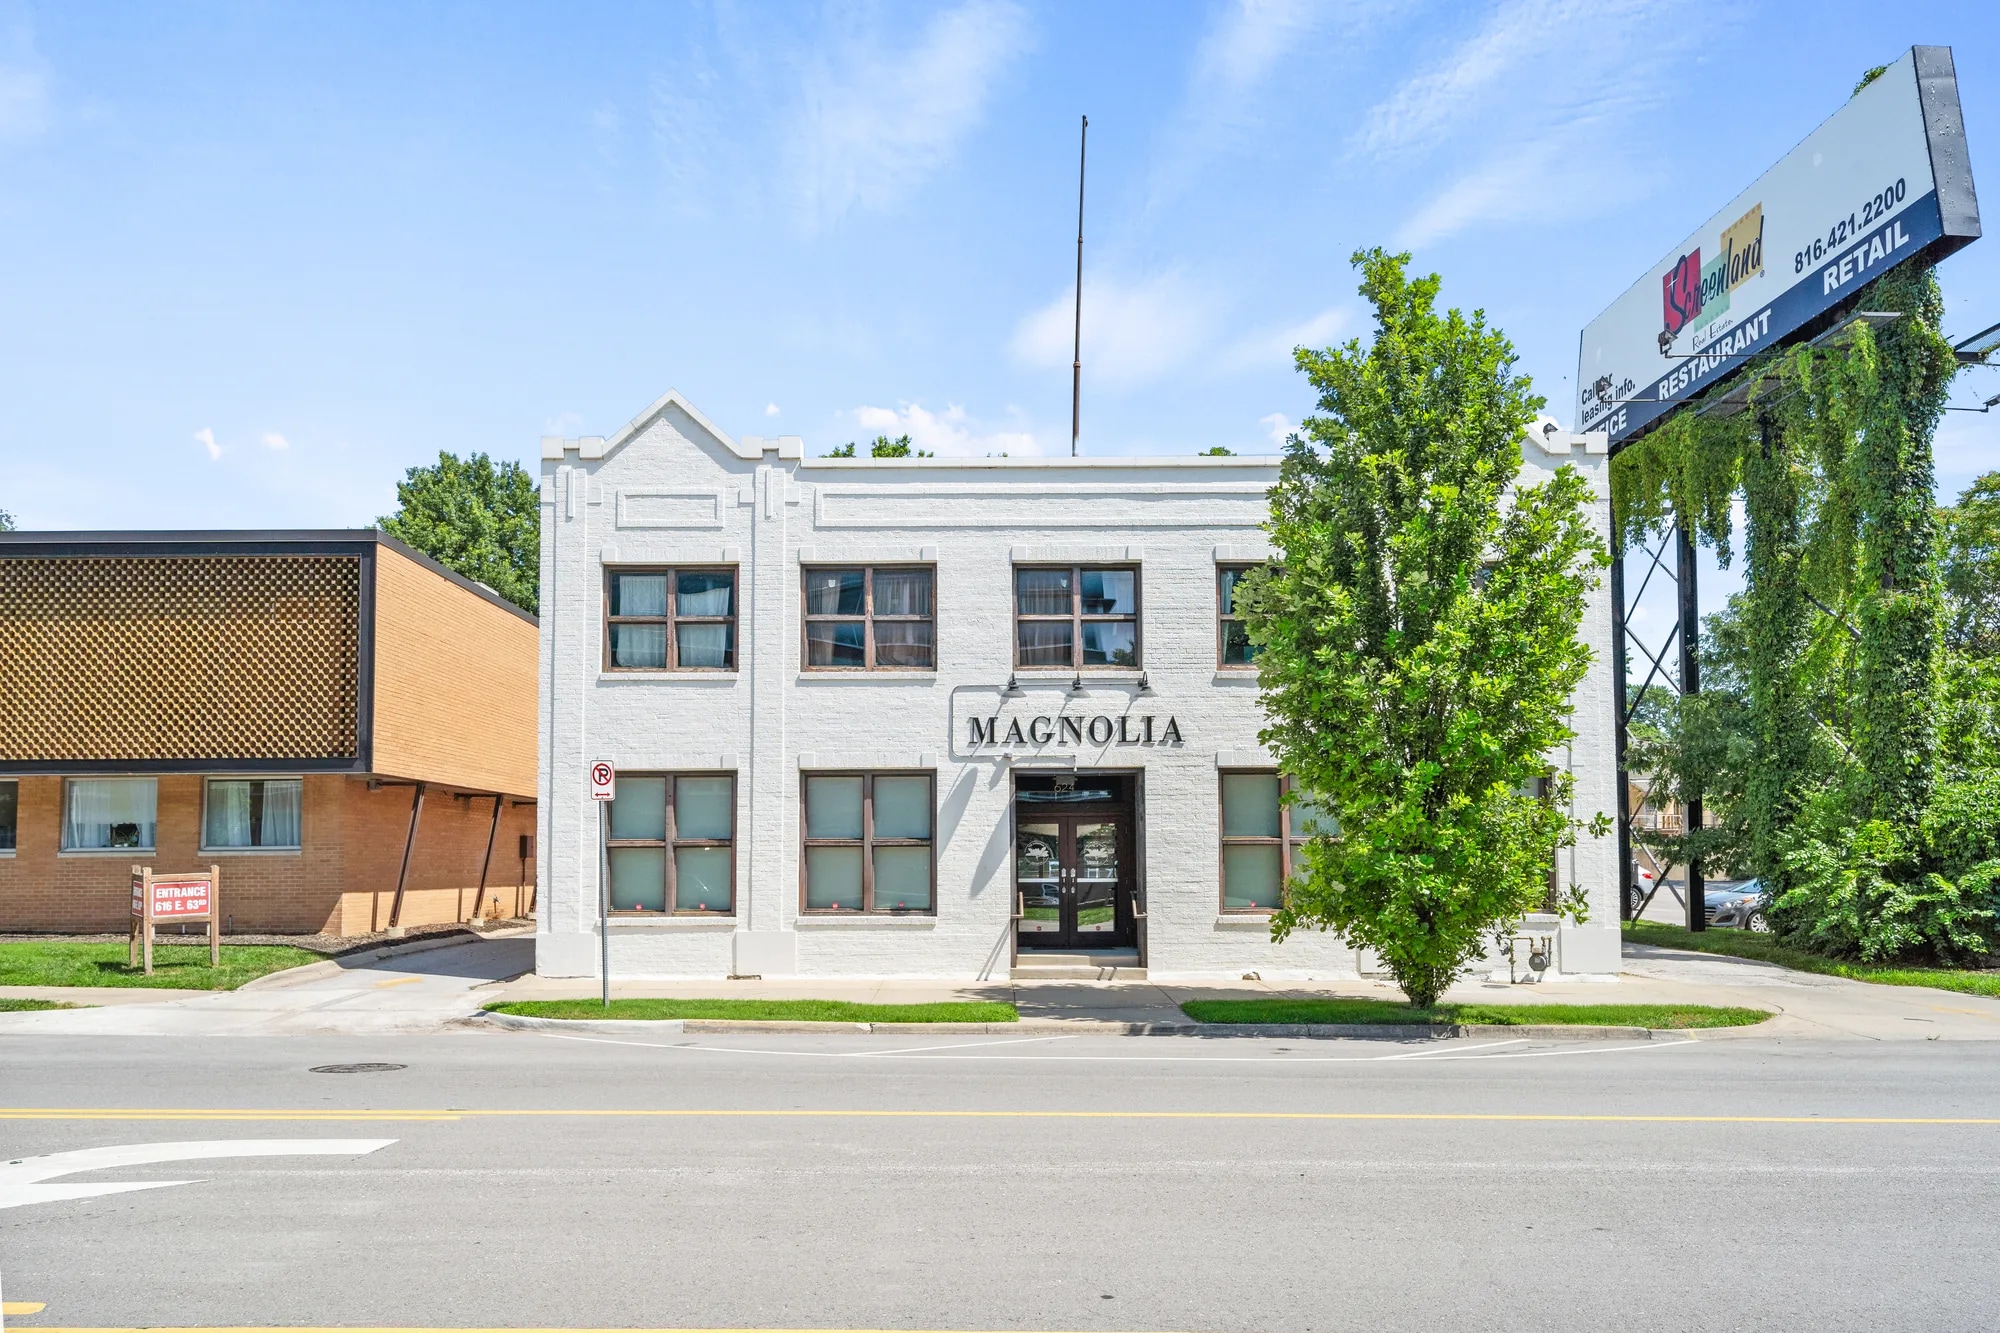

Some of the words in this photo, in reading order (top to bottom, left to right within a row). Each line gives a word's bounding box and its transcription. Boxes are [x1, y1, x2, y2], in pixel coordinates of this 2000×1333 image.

[1795, 178, 1906, 274] 816.421.2200
[1665, 215, 1764, 336] Screenland
[1659, 309, 1772, 402] RESTAURANT
[1823, 220, 1909, 296] RETAIL
[1615, 378, 1636, 401] info.
[968, 715, 1185, 744] MAGNOLIA
[1054, 782, 1075, 793] 624
[156, 886, 206, 899] ENTRANCE
[155, 901, 173, 912] 616
[174, 900, 184, 911] E.
